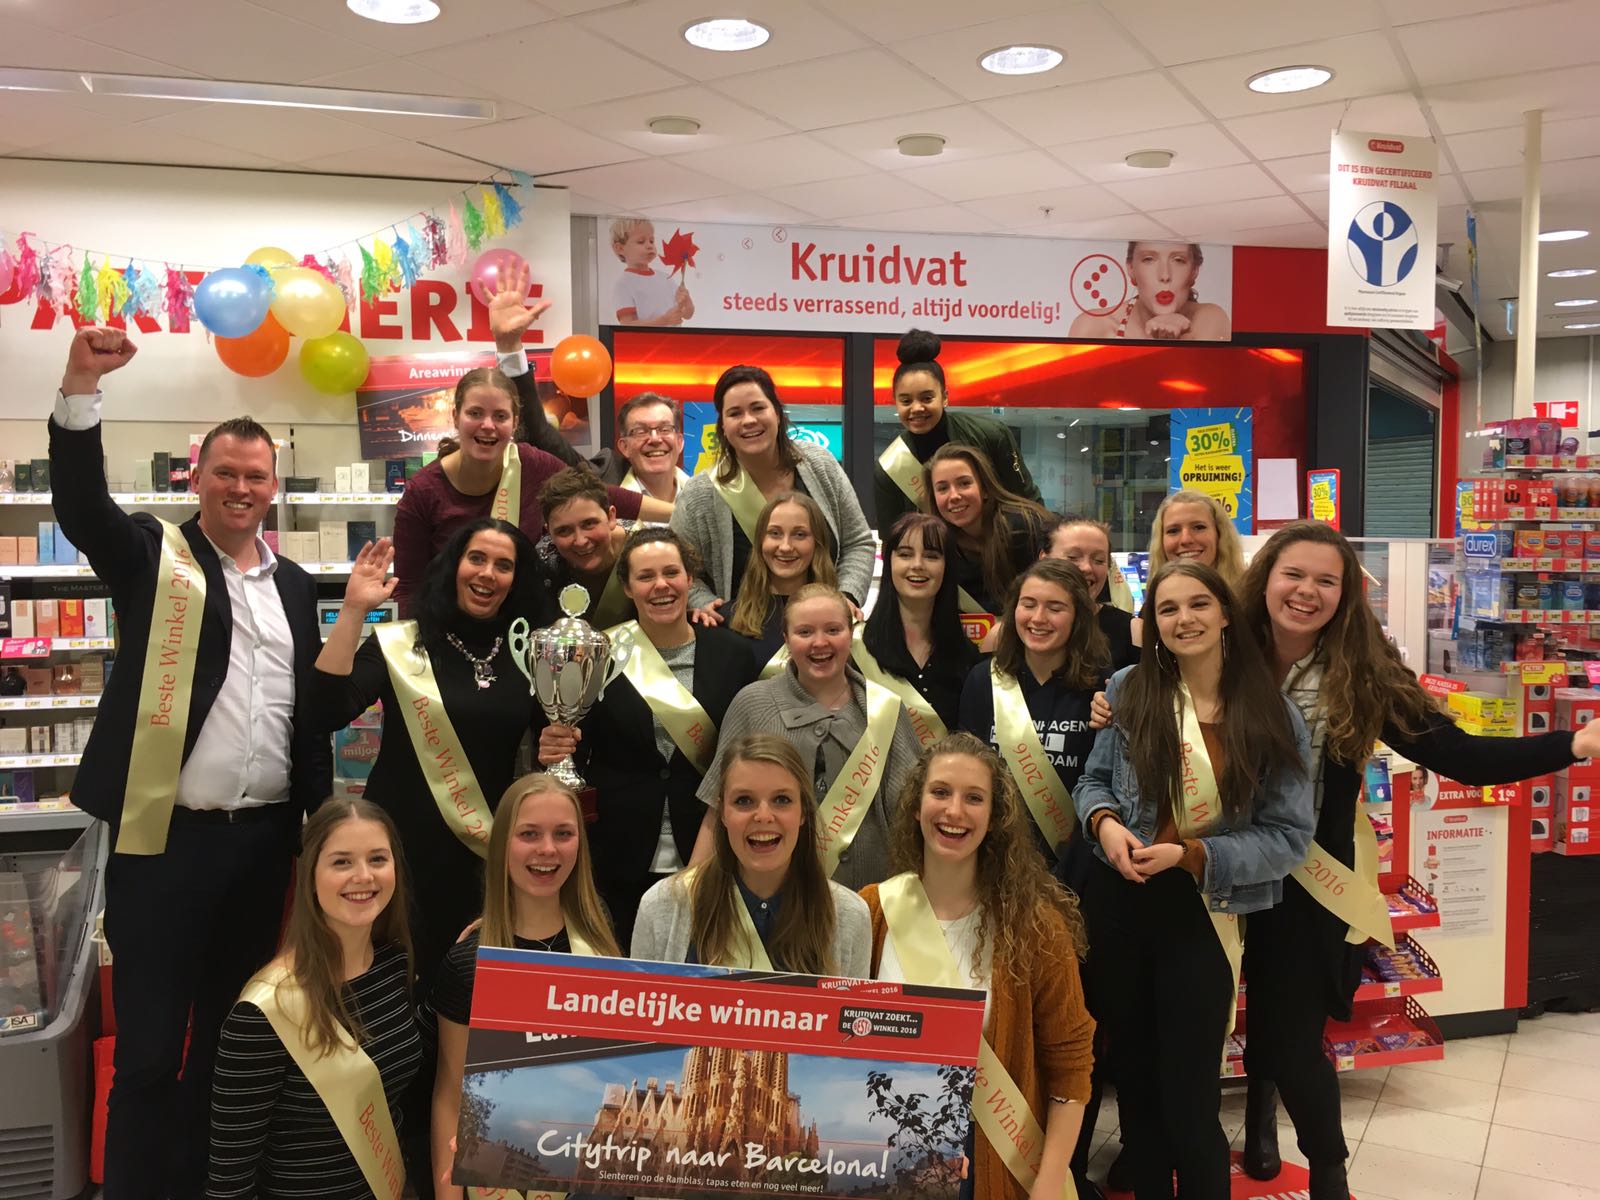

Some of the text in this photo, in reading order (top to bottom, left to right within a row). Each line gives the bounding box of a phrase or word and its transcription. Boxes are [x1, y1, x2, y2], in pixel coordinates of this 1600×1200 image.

[1338, 164, 1432, 179] DIT IS EEN GECERTIFICEERD
[1353, 178, 1417, 190] KRUIDVAT FILIAAL
[790, 242, 967, 287] Kruidvat
[723, 291, 1061, 324] steeds verrassend, altijd voordelig!
[1190, 431, 1230, 452] 30%
[1183, 473, 1242, 482] OPRUIMING!
[1466, 536, 1494, 552] durex
[151, 548, 192, 727] Beste Winkel 2016
[361, 732, 370, 745] 1
[412, 696, 440, 746] Beste
[435, 748, 477, 818] Winkel
[1013, 743, 1043, 785] 2016
[1179, 742, 1199, 797] Beste
[816, 744, 880, 852] Winkel 2016
[1439, 790, 1465, 800] EXTRA
[1426, 827, 1484, 841] INFORMATIE
[1303, 859, 1349, 896] 2016
[881, 986, 898, 994] 2016
[546, 985, 829, 1032] Landelijke winnaar
[844, 1009, 918, 1023] KRUIDVAT ZOEKT...
[11, 1016, 28, 1026] ISA
[873, 1025, 899, 1033] WINKEL
[900, 1026, 917, 1034] 2016
[359, 1101, 384, 1159] Beste
[985, 1087, 1035, 1160] Winkel
[536, 1130, 889, 1179] Citytrip naar Barcelona!
[599, 1170, 639, 1181] Slenteren
[641, 1175, 652, 1183] op
[654, 1174, 664, 1183] de
[666, 1175, 704, 1186] Ramblas,
[706, 1178, 729, 1188] tapas
[731, 1180, 749, 1188] eten
[763, 1182, 779, 1191] nog
[780, 1182, 798, 1191] veel
[800, 1184, 824, 1193] meer!
